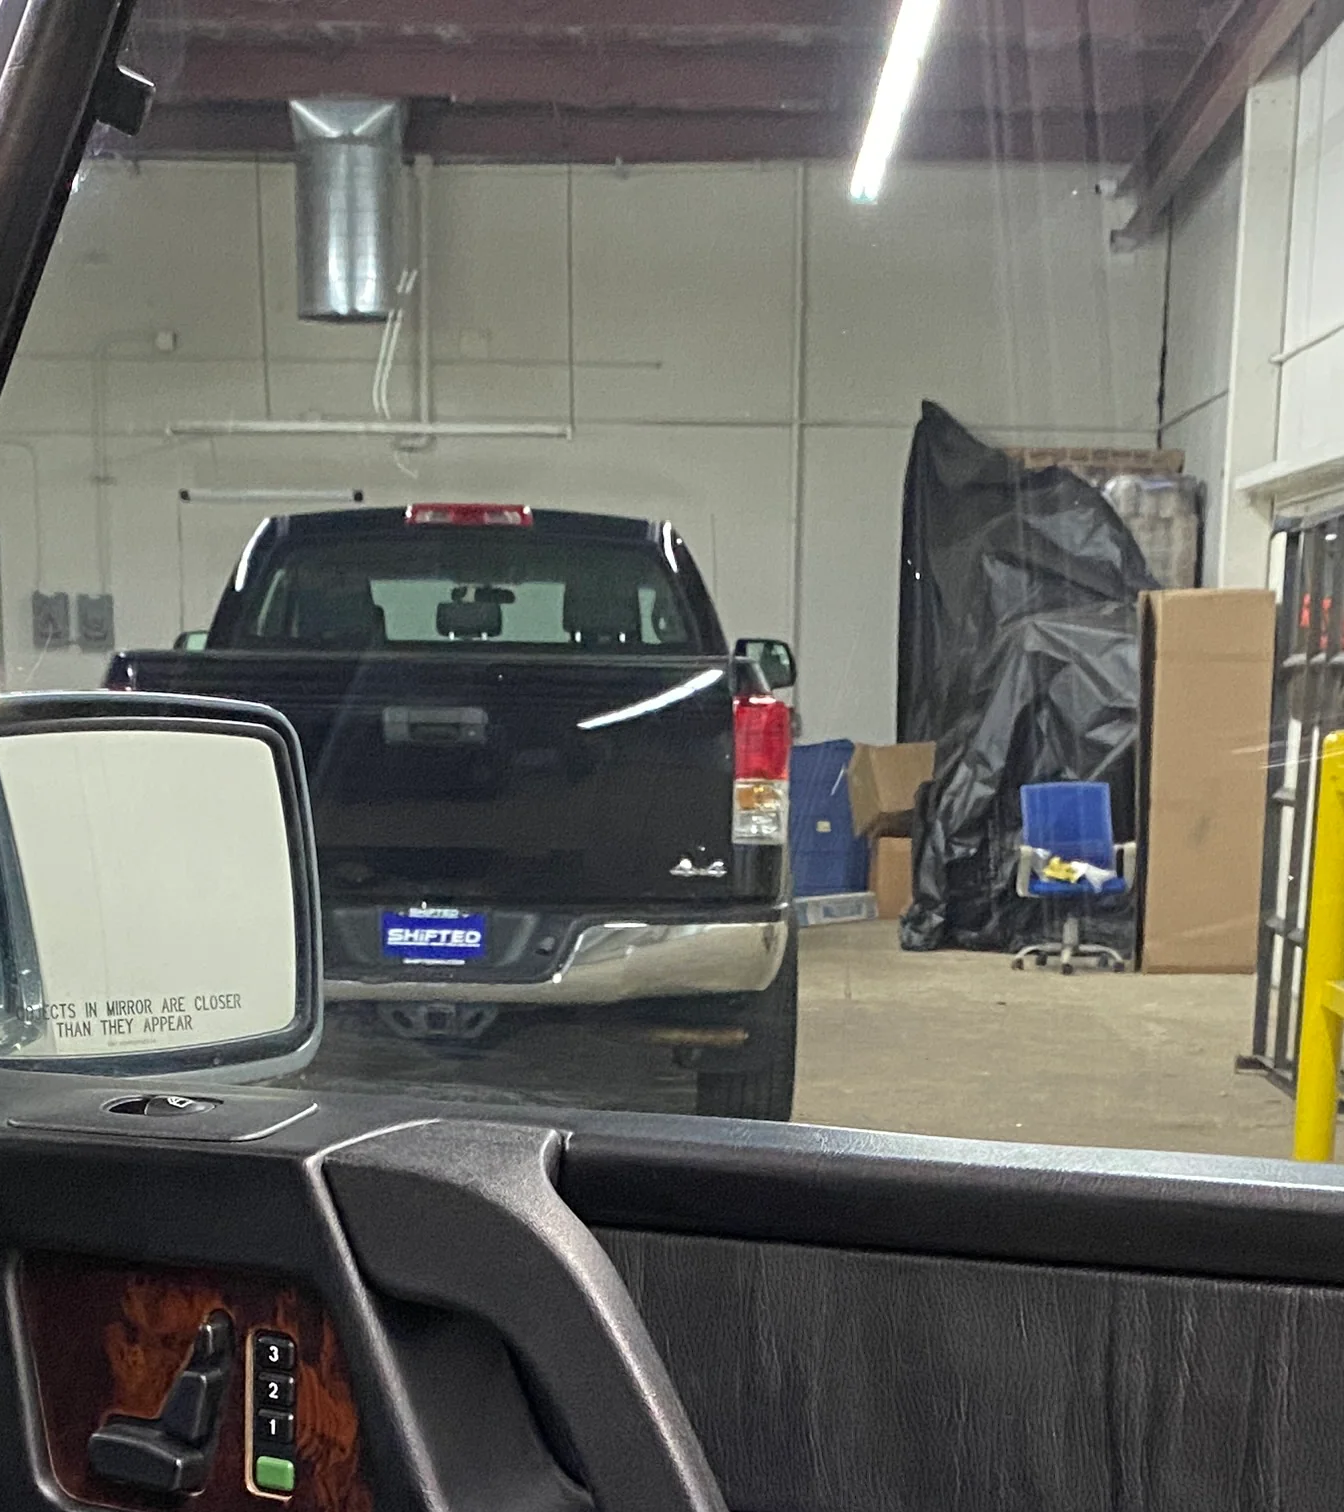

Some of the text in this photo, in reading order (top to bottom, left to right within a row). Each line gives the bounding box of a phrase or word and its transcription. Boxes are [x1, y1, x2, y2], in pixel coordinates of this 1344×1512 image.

[85, 1001, 97, 1017] IN
[106, 998, 153, 1016] MIRROR
[161, 996, 186, 1013] ARE
[194, 993, 242, 1011] CLOSER
[56, 1014, 193, 1038] THAN THEY APPEAR
[269, 1345, 279, 1362] 3
[268, 1382, 278, 1399] 2
[270, 1419, 277, 1435] 1
